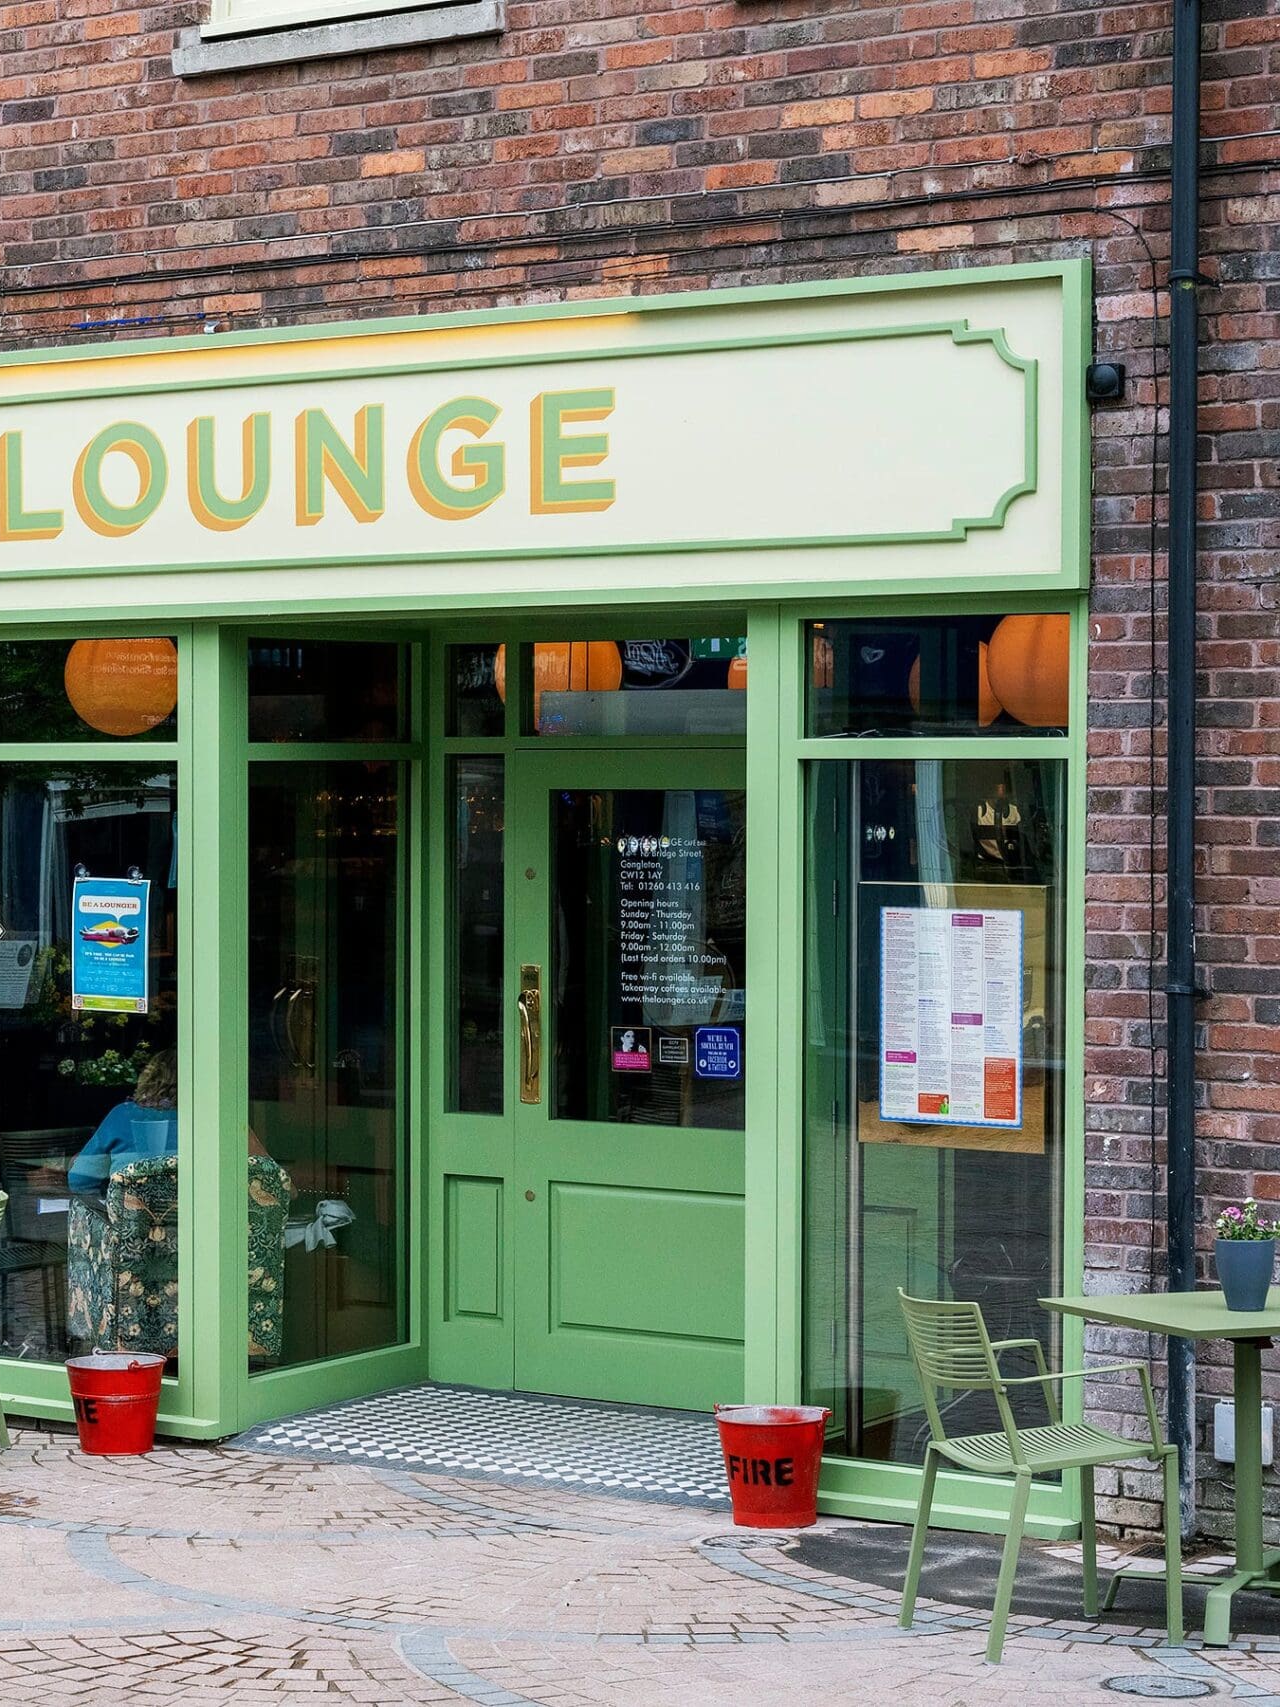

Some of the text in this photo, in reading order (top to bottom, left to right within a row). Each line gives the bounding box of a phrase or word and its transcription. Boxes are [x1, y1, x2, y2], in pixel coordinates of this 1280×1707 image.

[652, 850, 676, 859] Bridge
[678, 849, 704, 859] Street,
[620, 860, 663, 870] Congleton,
[620, 871, 662, 879] CW12 1AY
[621, 882, 700, 891] Tel: 01260 413 416
[620, 899, 679, 909] Opening hours
[620, 909, 649, 919] Sunday
[656, 910, 692, 920] Thursday
[621, 921, 651, 929] 9.00am
[659, 921, 695, 931] 11.00pm
[621, 931, 644, 941] Friday
[652, 932, 687, 942] Saturday
[621, 942, 651, 951] 9.00am
[660, 943, 695, 952] 12.00am
[621, 953, 727, 964] (Last food orders 10.00pm)
[621, 972, 637, 980] Free
[640, 972, 657, 980] wi-fi
[621, 983, 659, 993] Takeaway
[661, 984, 688, 993] coffees
[621, 995, 708, 1005] www.thelounges.co.uk
[728, 1454, 794, 1486] FIRE
